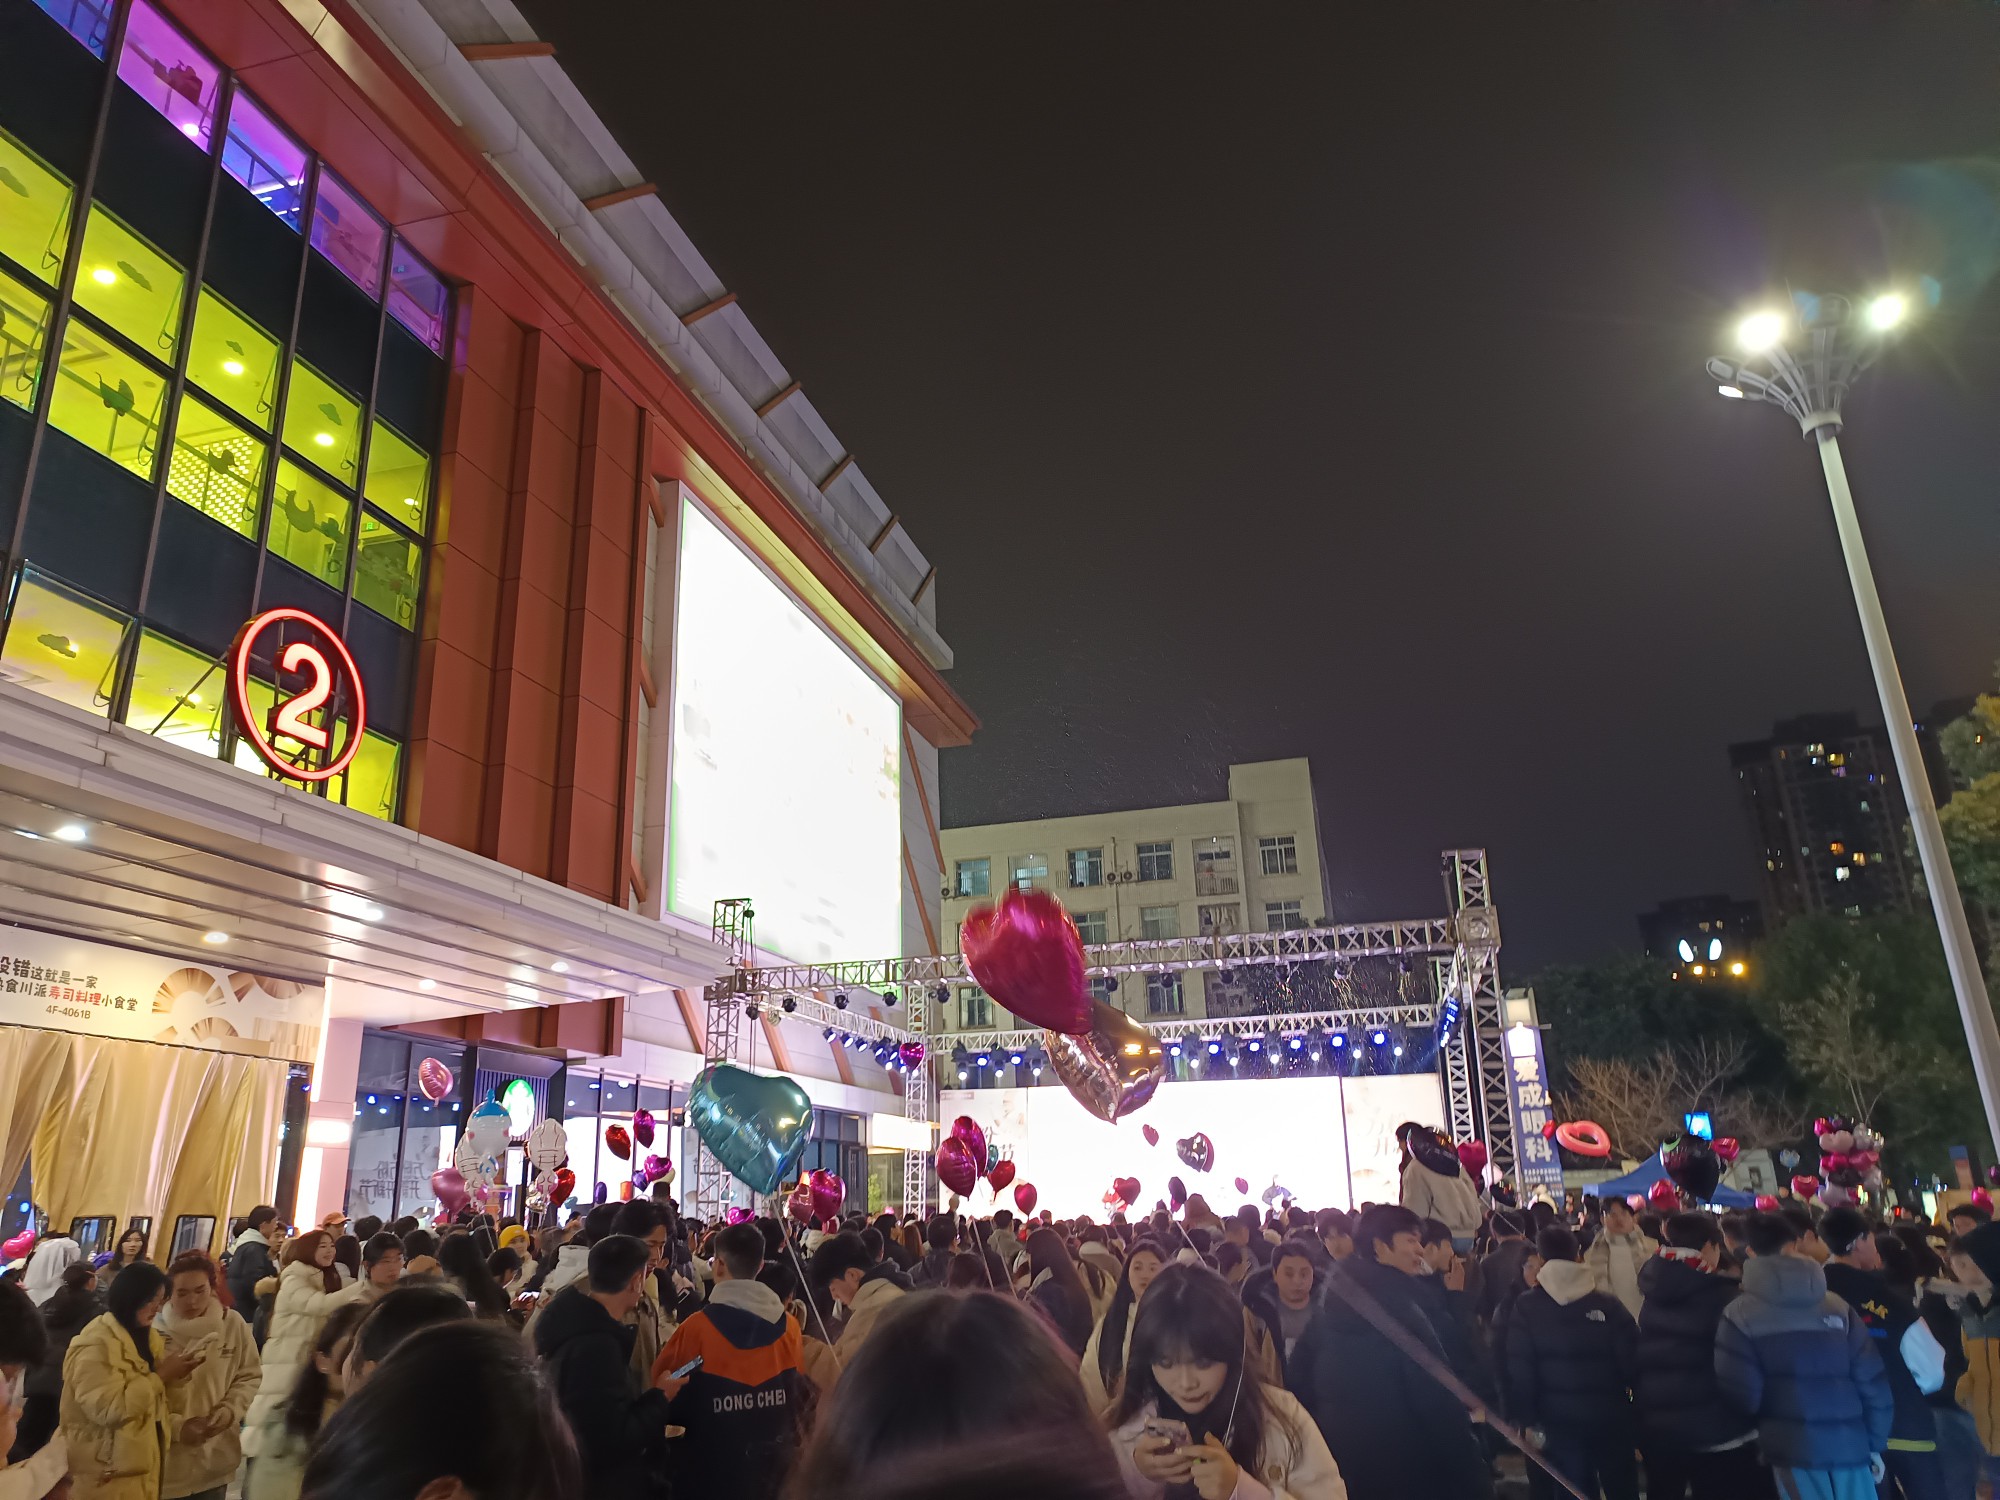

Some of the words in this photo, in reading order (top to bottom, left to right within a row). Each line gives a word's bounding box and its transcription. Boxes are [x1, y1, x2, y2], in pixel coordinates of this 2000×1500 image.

[276, 642, 332, 748] 2
[45, 1005, 91, 1019] 4F-4061B
[713, 1393, 754, 1413] DONG
